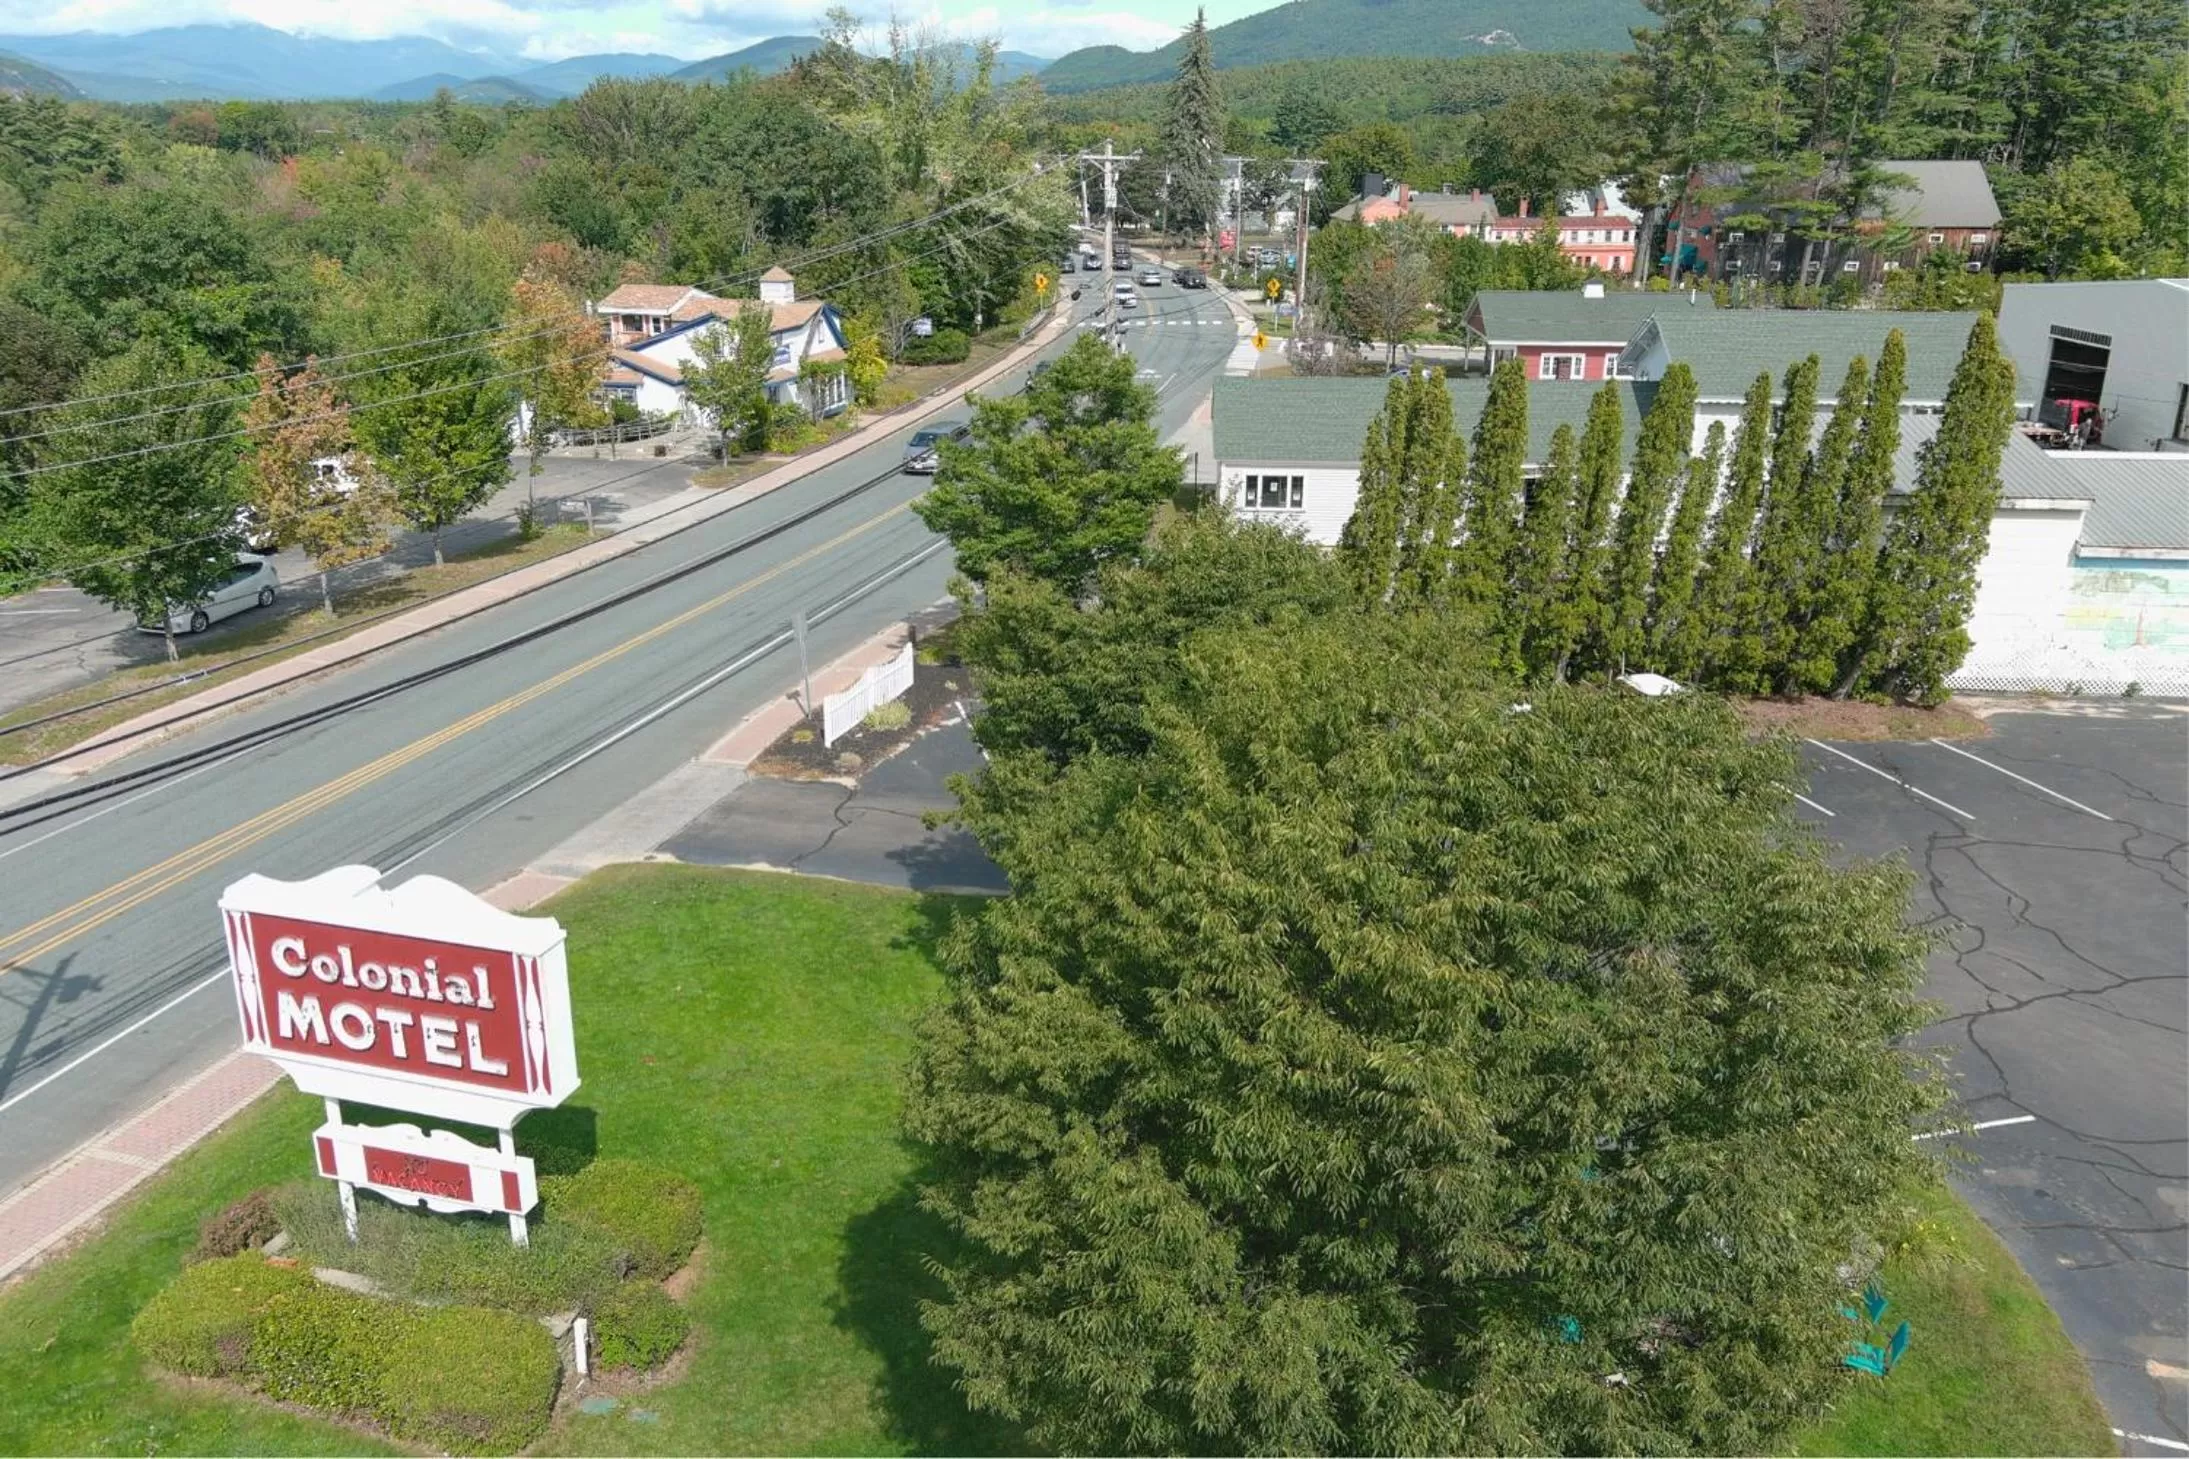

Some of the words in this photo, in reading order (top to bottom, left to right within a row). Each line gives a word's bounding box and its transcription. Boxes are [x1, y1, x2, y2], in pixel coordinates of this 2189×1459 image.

[271, 936, 495, 1010] Colonial
[278, 991, 509, 1077] MOTEL
[372, 1167, 464, 1198] VACANCY
